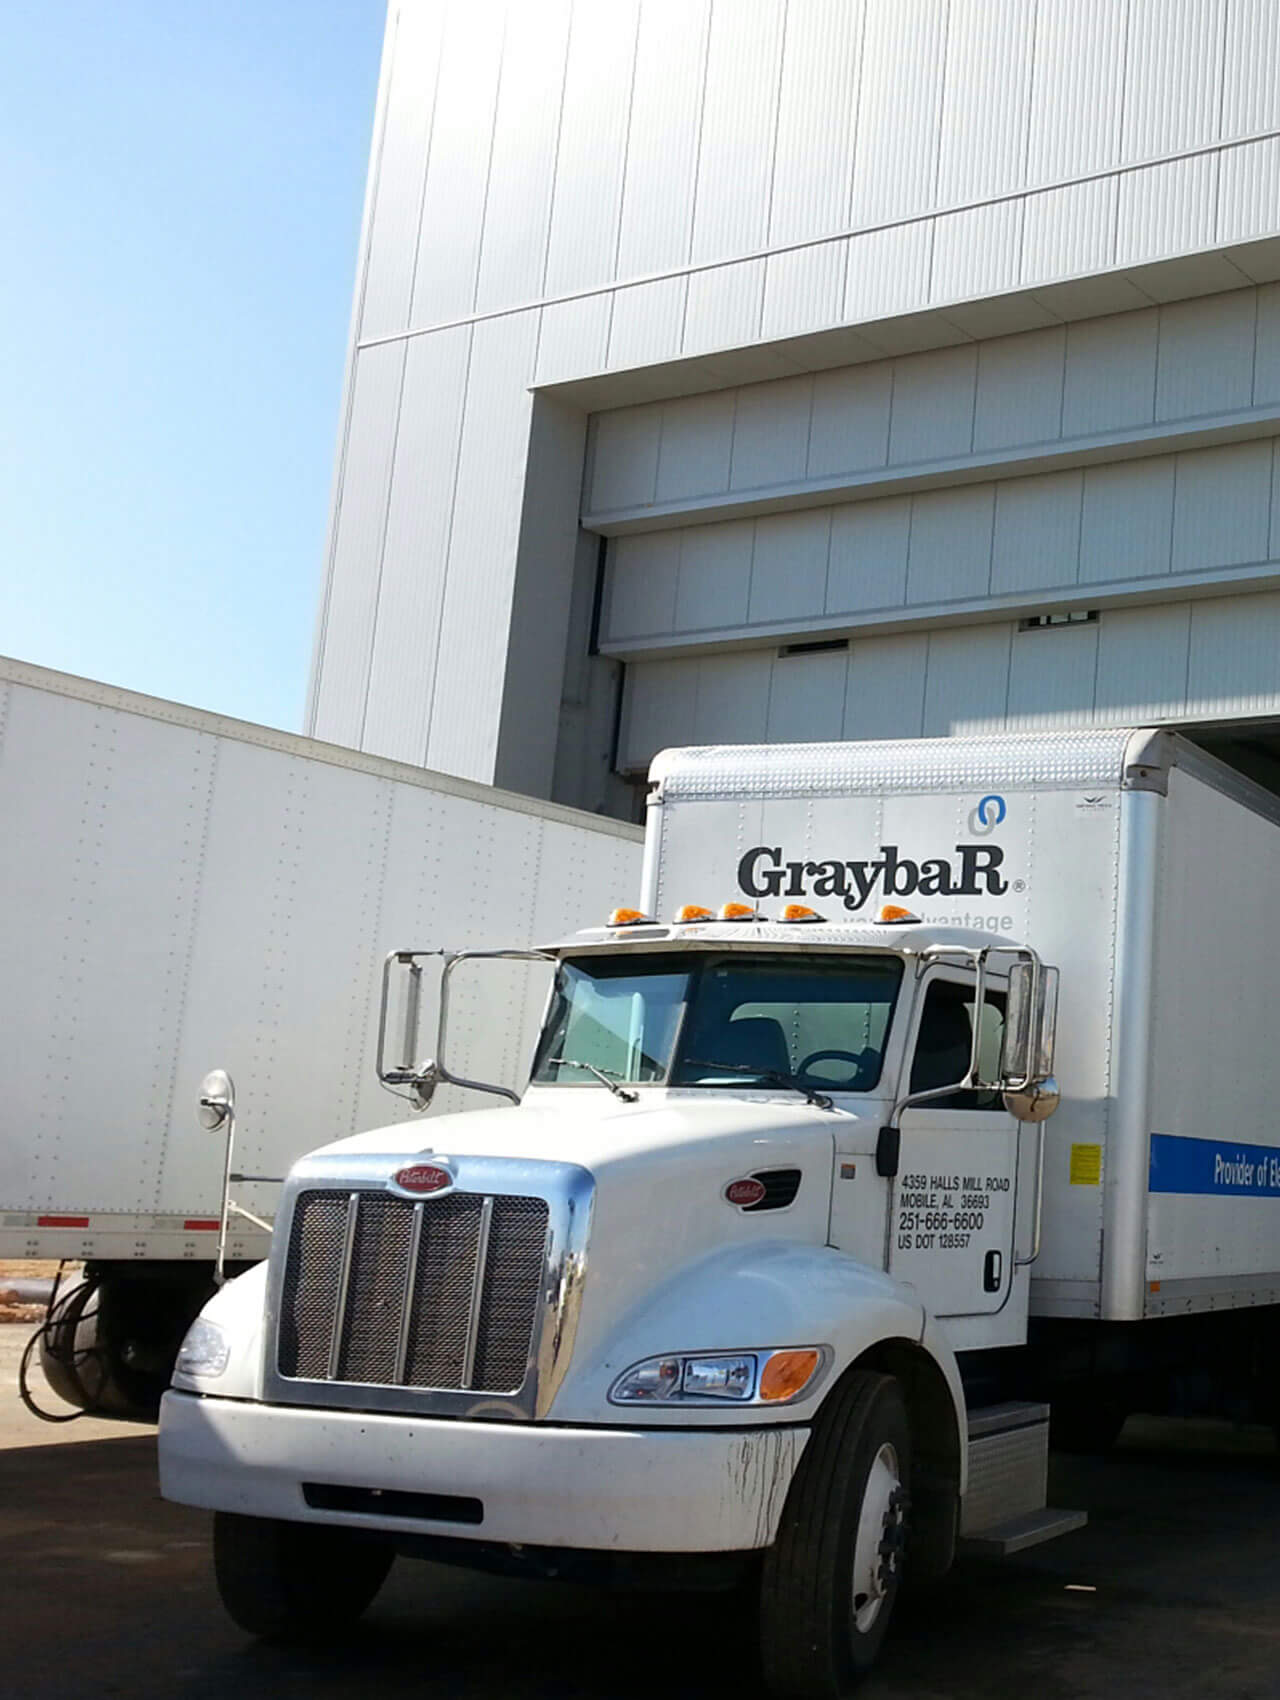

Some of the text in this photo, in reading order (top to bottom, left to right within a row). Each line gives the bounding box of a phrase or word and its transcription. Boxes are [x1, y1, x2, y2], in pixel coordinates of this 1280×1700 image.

[1214, 1153, 1254, 1186] Provider
[1257, 1156, 1268, 1187] of
[902, 1175, 1010, 1192] 4359 HALLS MILL ROAD
[900, 1193, 990, 1210] MOBILE, AL 36693
[900, 1212, 984, 1230] 251-666-6600
[898, 1234, 971, 1249] US DOT 128557
